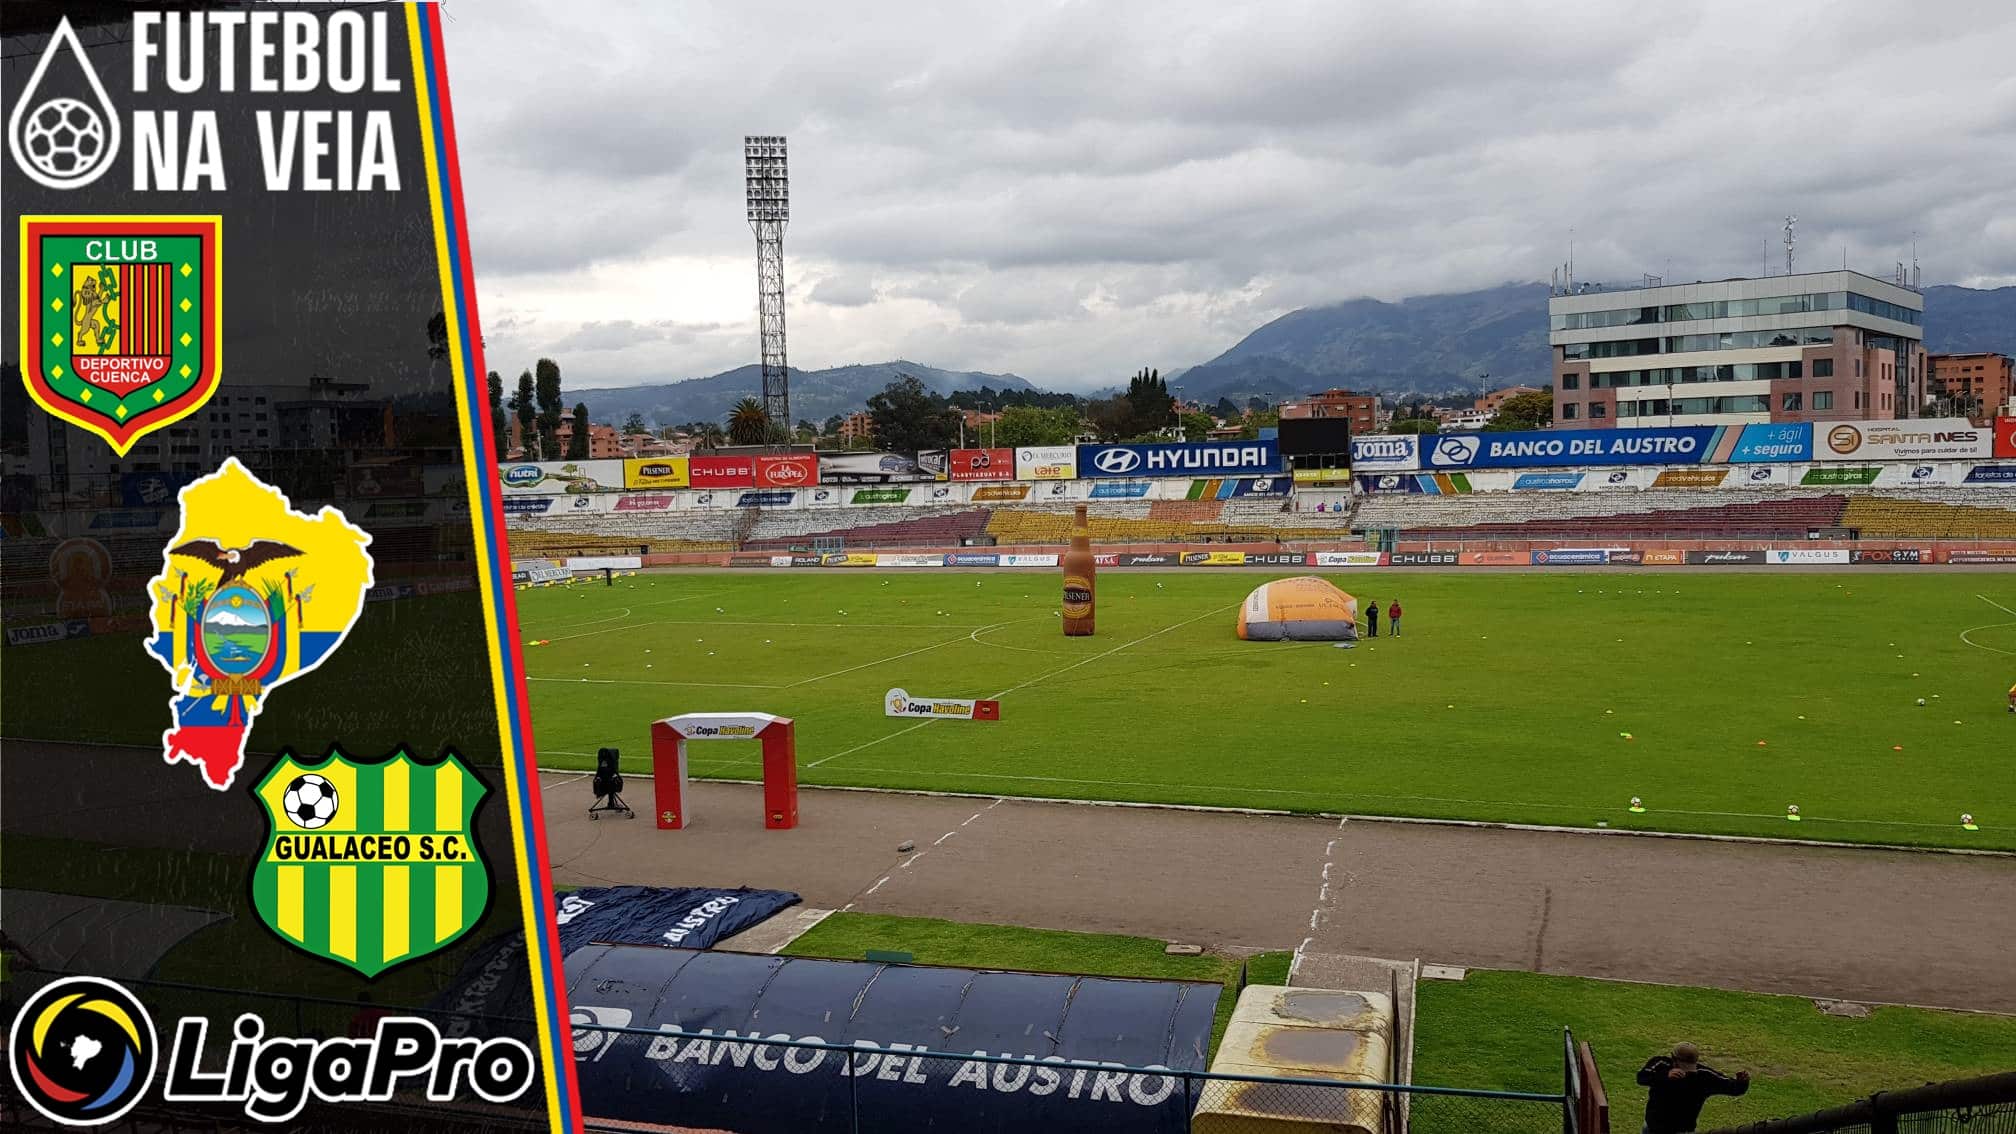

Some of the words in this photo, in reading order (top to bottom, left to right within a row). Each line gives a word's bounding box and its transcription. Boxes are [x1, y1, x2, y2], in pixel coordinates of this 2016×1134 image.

[1778, 426, 1803, 443] ágil
[1867, 433, 1931, 445] SANTA
[1933, 431, 1978, 443] INES
[1490, 439, 1564, 457] BANCO
[1569, 439, 1605, 455] DEL
[1609, 436, 1696, 454] AUSTRO
[1753, 444, 1803, 457] seguro
[1894, 447, 1920, 456] Vivimos
[1147, 447, 1267, 469] HYUNDAI
[642, 466, 672, 475] PILSENER
[692, 468, 748, 476] CHUBB
[1244, 555, 1302, 563] CHUBB
[1328, 555, 1347, 563] Copa
[1392, 555, 1455, 563] CHUBB
[1861, 550, 1893, 561] FOX
[908, 702, 932, 714] Copa
[932, 703, 971, 715] Havoline
[696, 726, 718, 737] Copa
[719, 725, 755, 736] Havoline
[644, 1023, 827, 1074] BANCO
[840, 1039, 929, 1085] DEL
[948, 1050, 1176, 1107] AUSTRO
